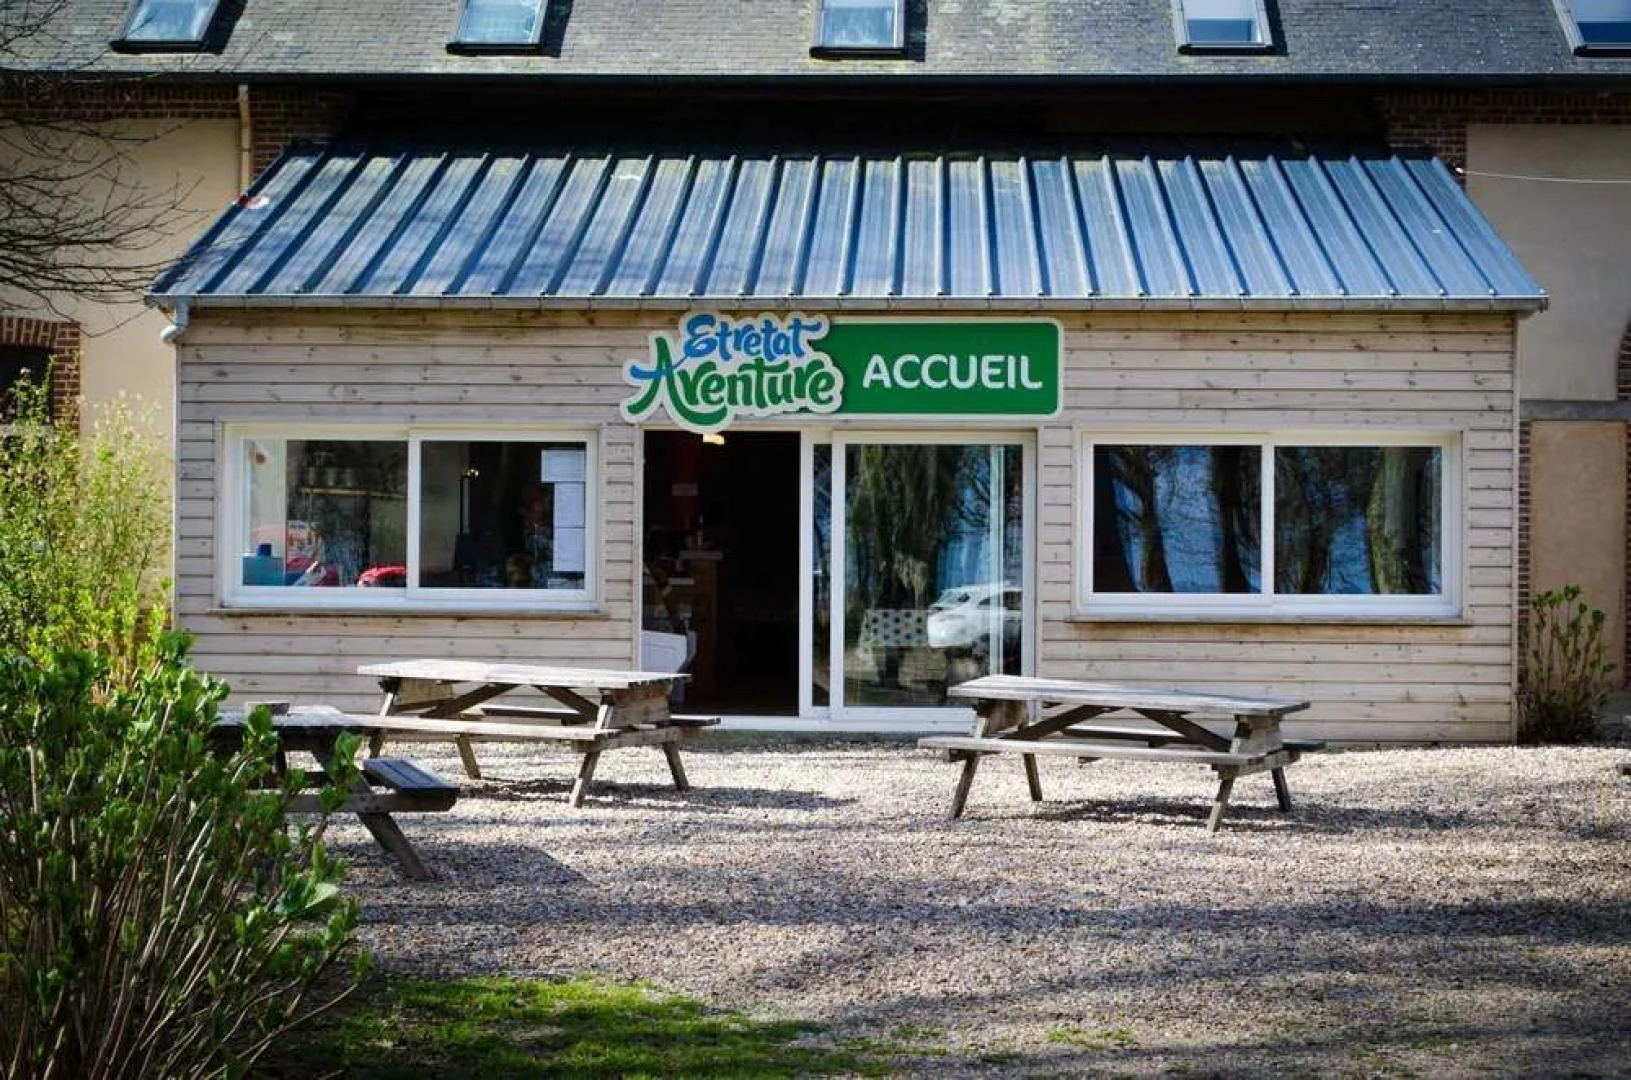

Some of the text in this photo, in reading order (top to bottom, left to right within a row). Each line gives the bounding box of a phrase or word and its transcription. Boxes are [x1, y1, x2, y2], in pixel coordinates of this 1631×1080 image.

[683, 312, 823, 362] Etretat
[627, 335, 836, 425] Aventure
[862, 353, 1043, 389] ACCUEIL
